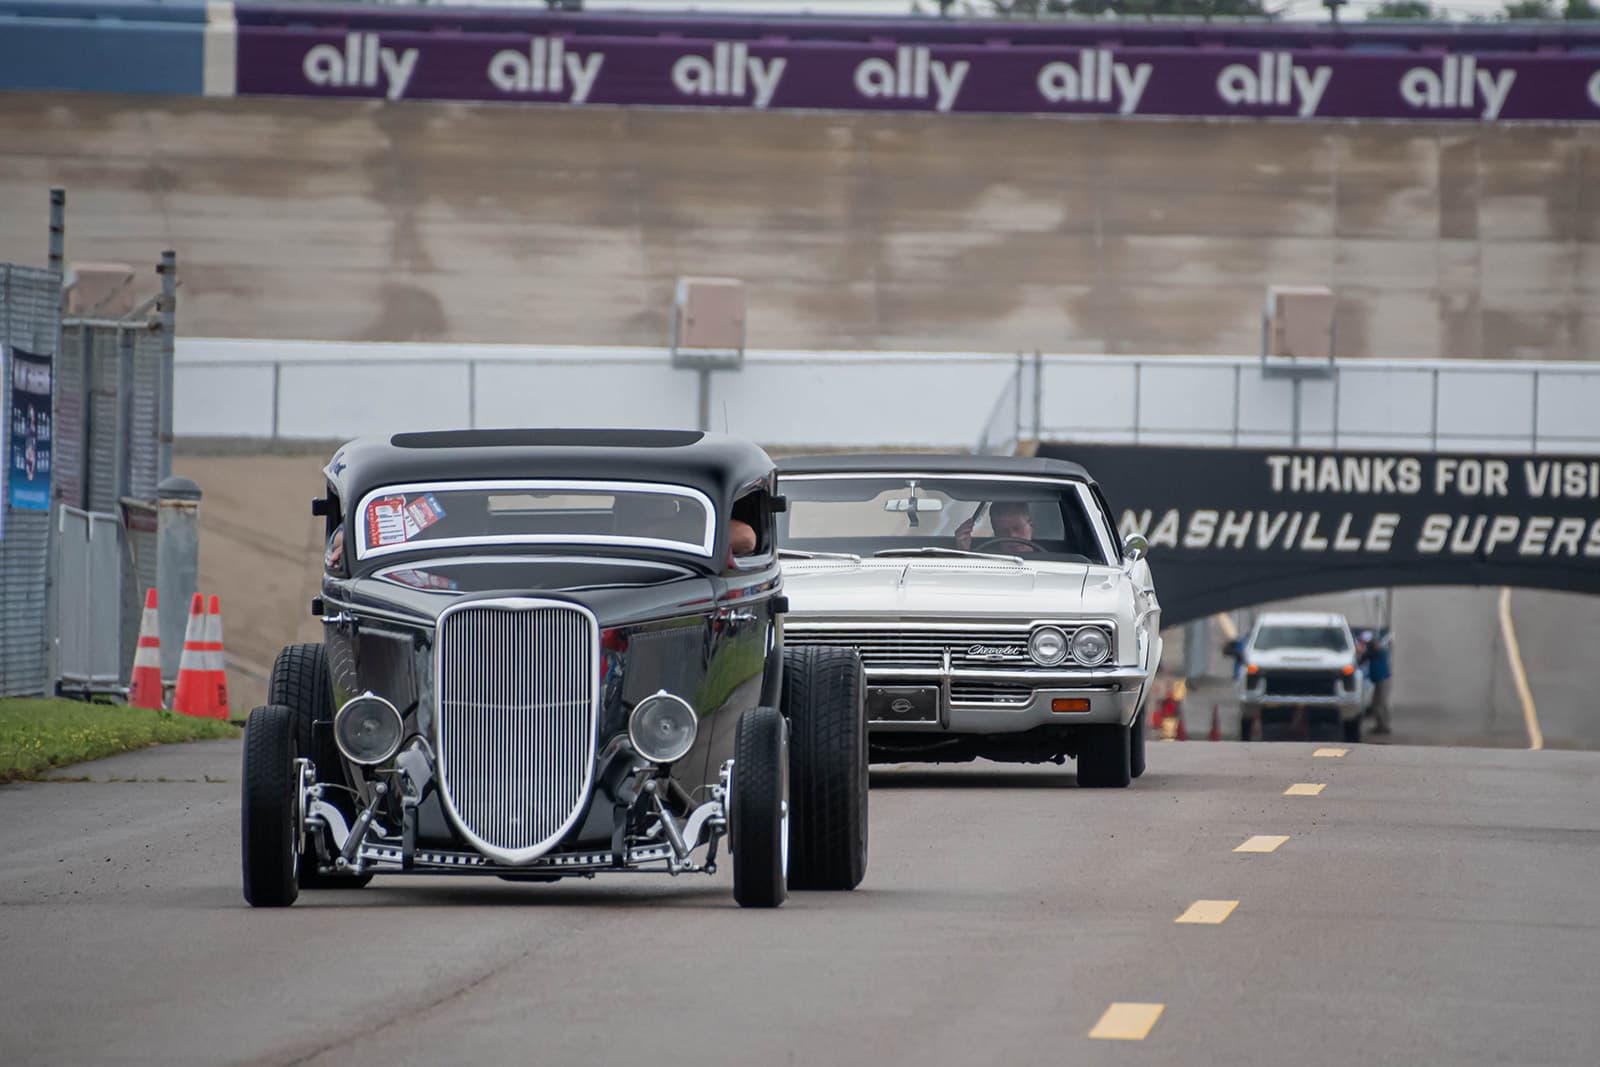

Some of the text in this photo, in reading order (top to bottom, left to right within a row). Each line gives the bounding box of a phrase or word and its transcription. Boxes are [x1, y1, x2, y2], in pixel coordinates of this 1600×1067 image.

[303, 33, 419, 99] ally
[488, 37, 604, 103] ally
[672, 41, 787, 107] ally
[853, 45, 970, 111] ally
[1037, 48, 1152, 115] ally
[1217, 51, 1333, 117] ally
[1400, 54, 1516, 120] ally
[1266, 455, 1599, 498] THANKS FOR VISI
[1119, 508, 1401, 552] NASHVILLE
[967, 644, 1020, 655] Chevrolet
